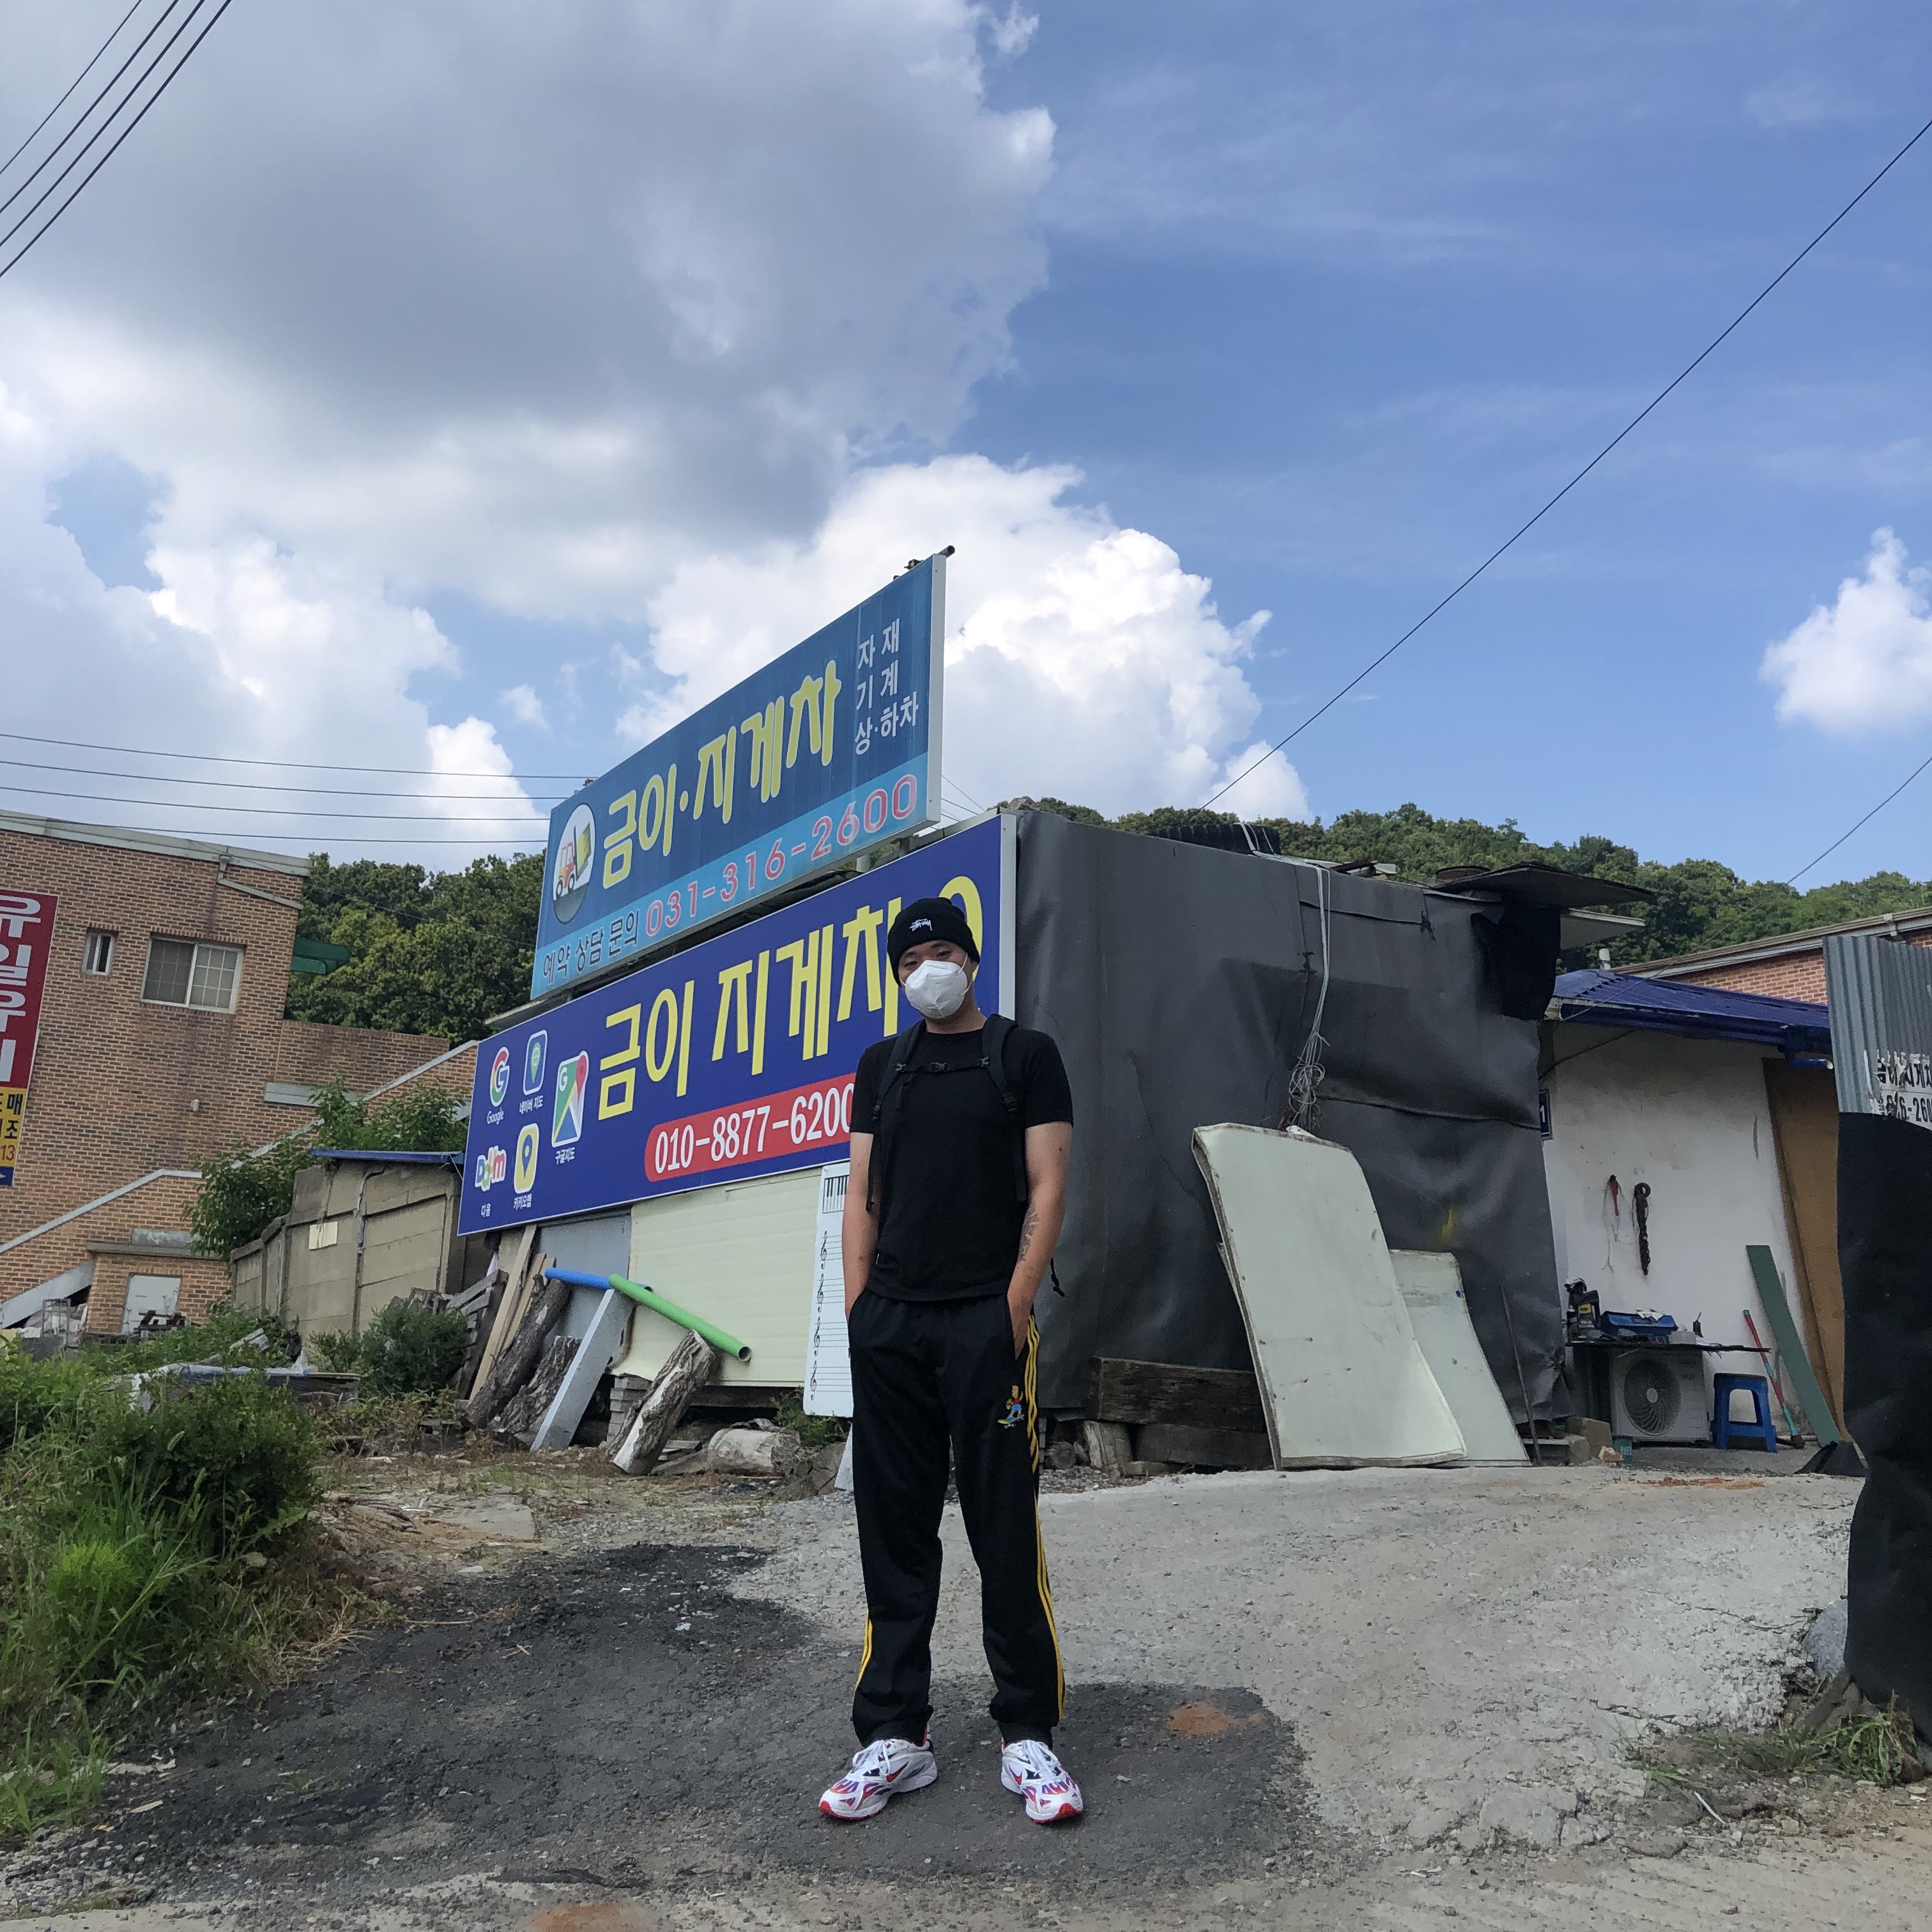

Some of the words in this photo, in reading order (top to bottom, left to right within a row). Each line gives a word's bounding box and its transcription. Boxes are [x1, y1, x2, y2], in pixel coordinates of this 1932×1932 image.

[542, 949, 571, 985] 예약
[575, 930, 604, 972] 상담
[608, 908, 639, 958] 문의
[645, 773, 917, 937] 031-316-2600
[598, 980, 694, 1121] 금이
[486, 1107, 504, 1125] Google
[655, 1083, 854, 1174] 010-8877-6200
[480, 1203, 491, 1218] 다음
